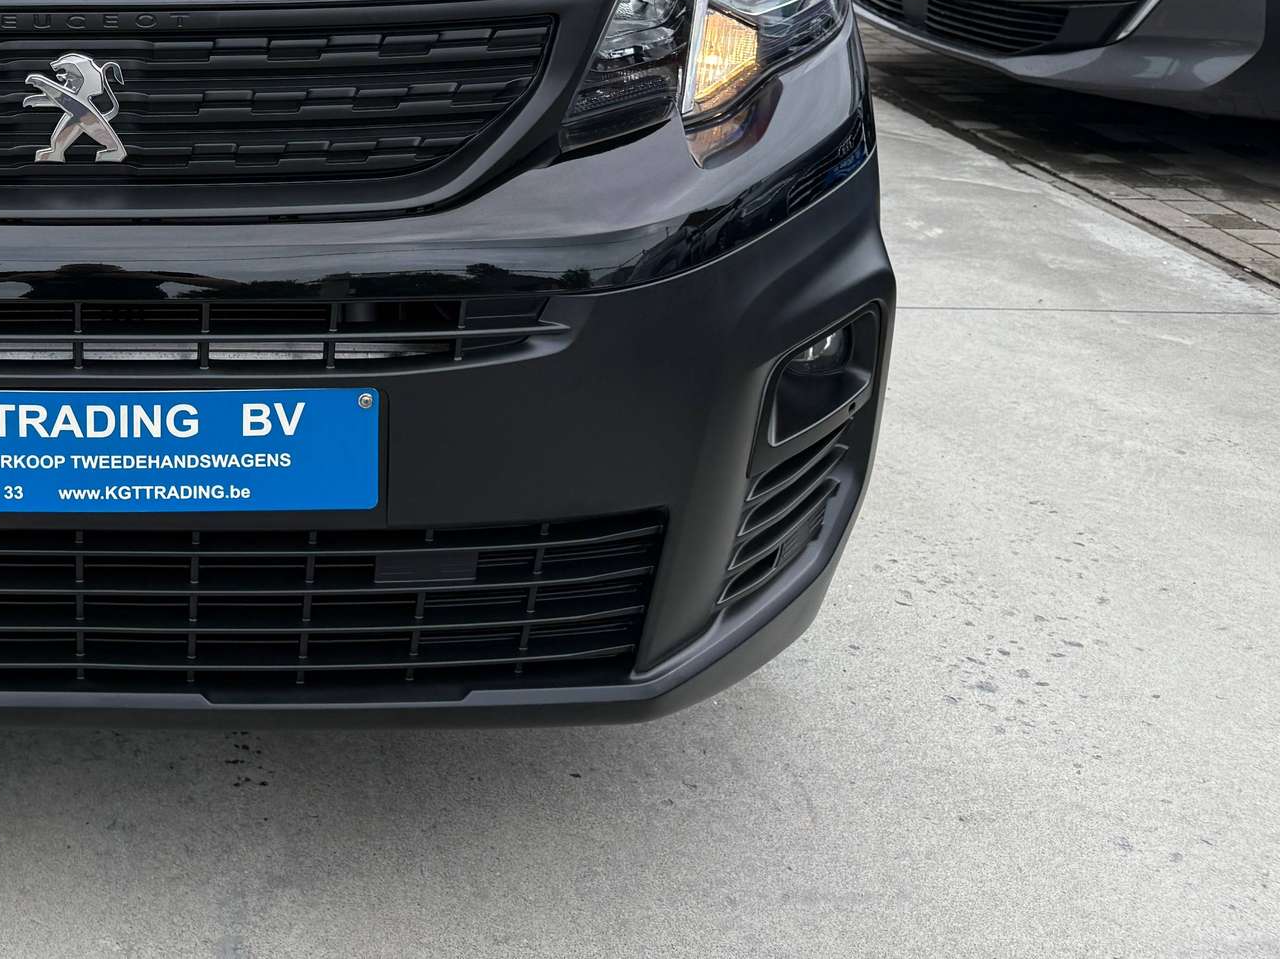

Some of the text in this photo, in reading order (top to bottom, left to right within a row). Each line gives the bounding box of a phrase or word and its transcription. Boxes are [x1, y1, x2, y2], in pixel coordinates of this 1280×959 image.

[242, 402, 306, 437] BV
[70, 453, 292, 470] TWEEDEHANDSWAGENS
[3, 486, 24, 500] 33
[58, 484, 251, 500] www.KGTTRADING.be
